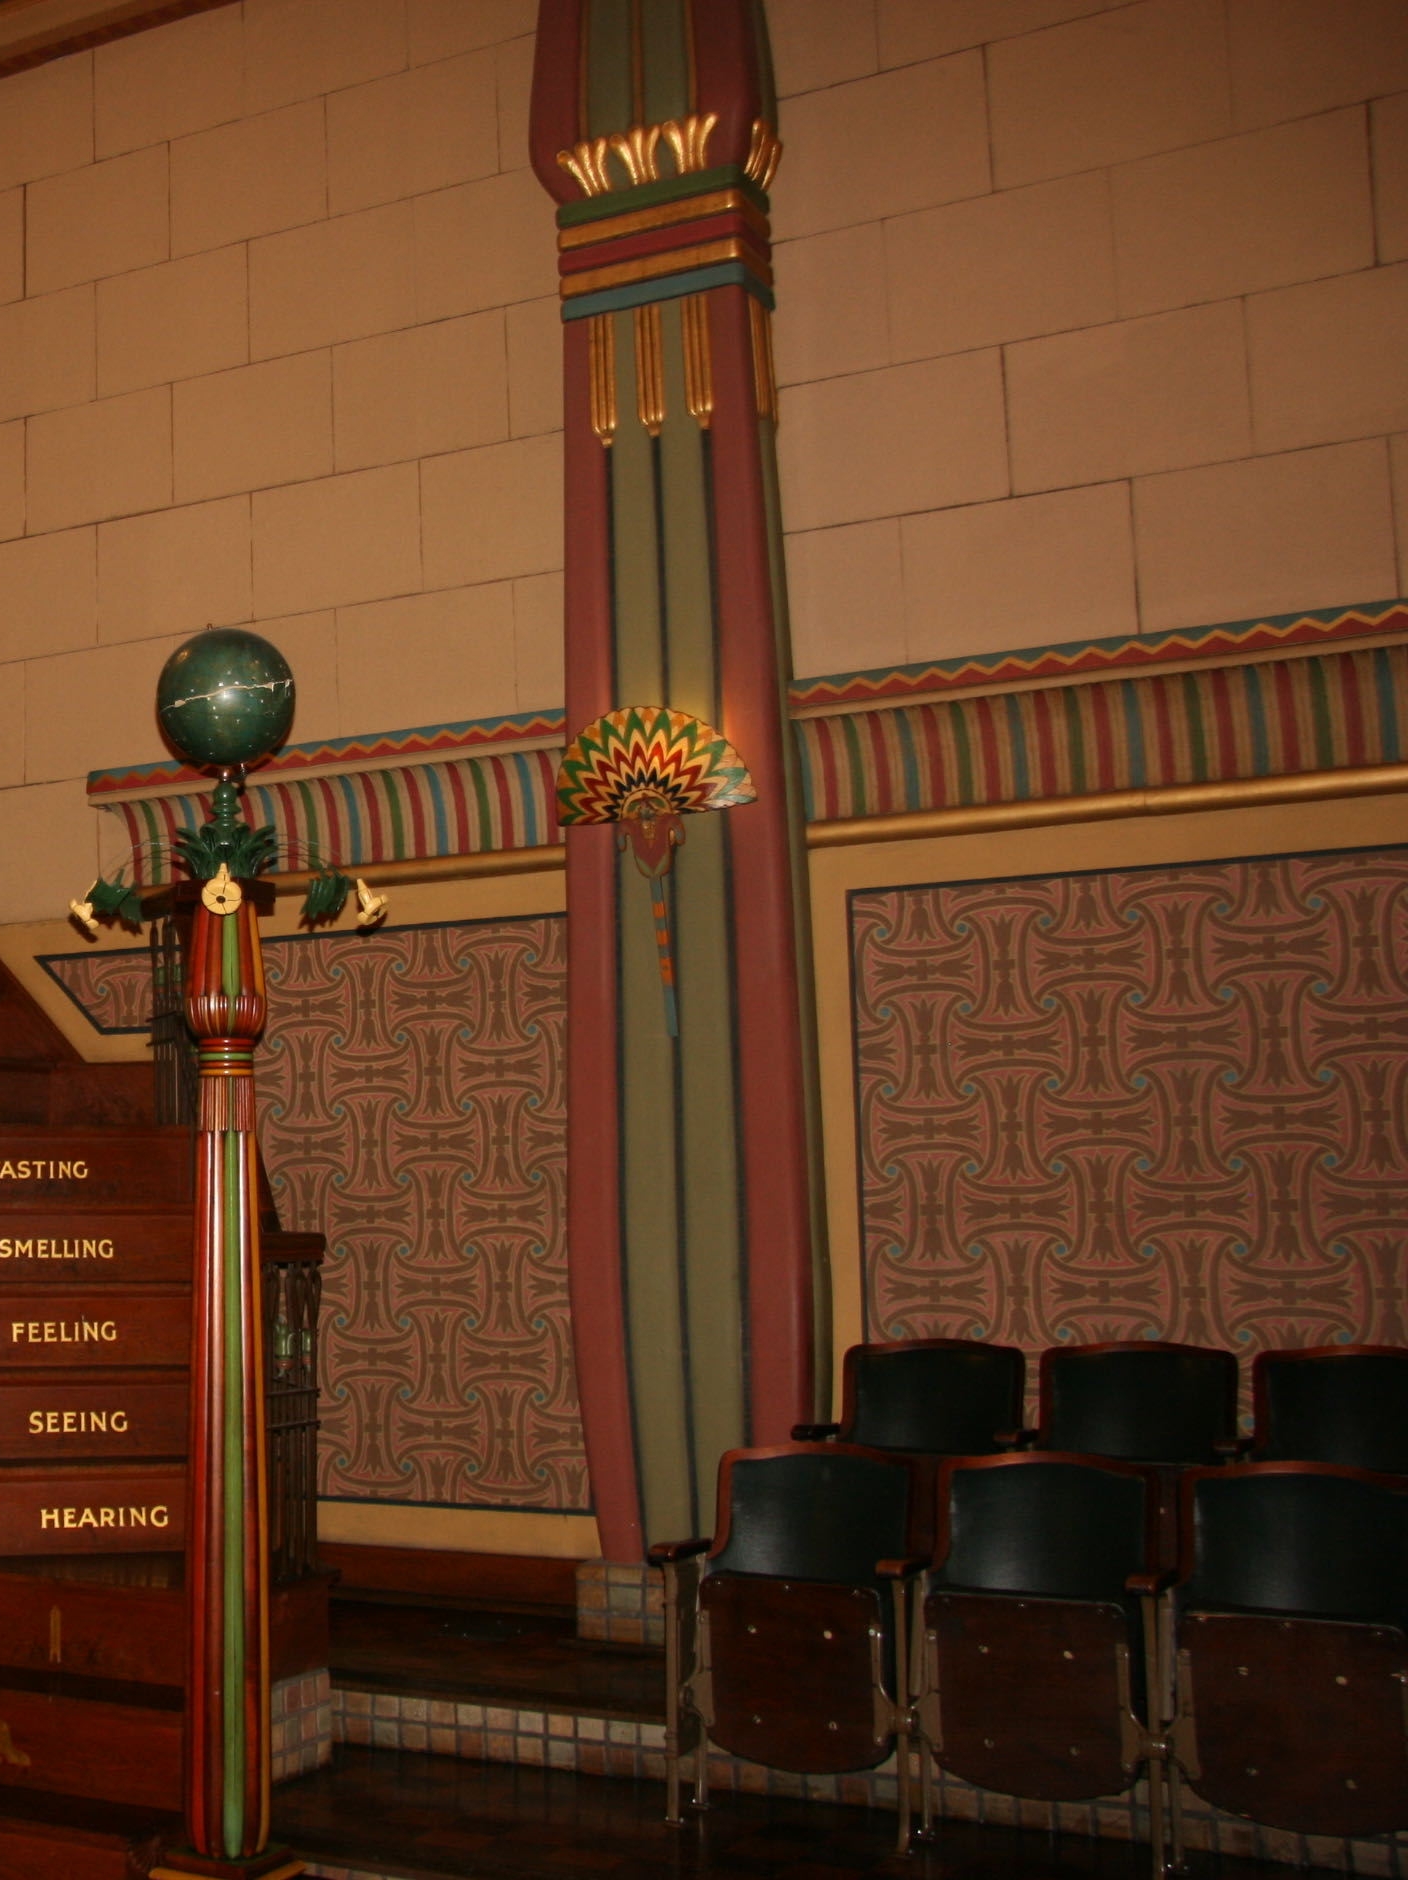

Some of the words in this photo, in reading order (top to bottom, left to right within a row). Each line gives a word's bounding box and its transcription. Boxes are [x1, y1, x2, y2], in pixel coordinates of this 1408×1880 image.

[11, 1321, 117, 1343] FEELING
[28, 1410, 128, 1434] SEEING
[40, 1505, 169, 1529] HEARING
